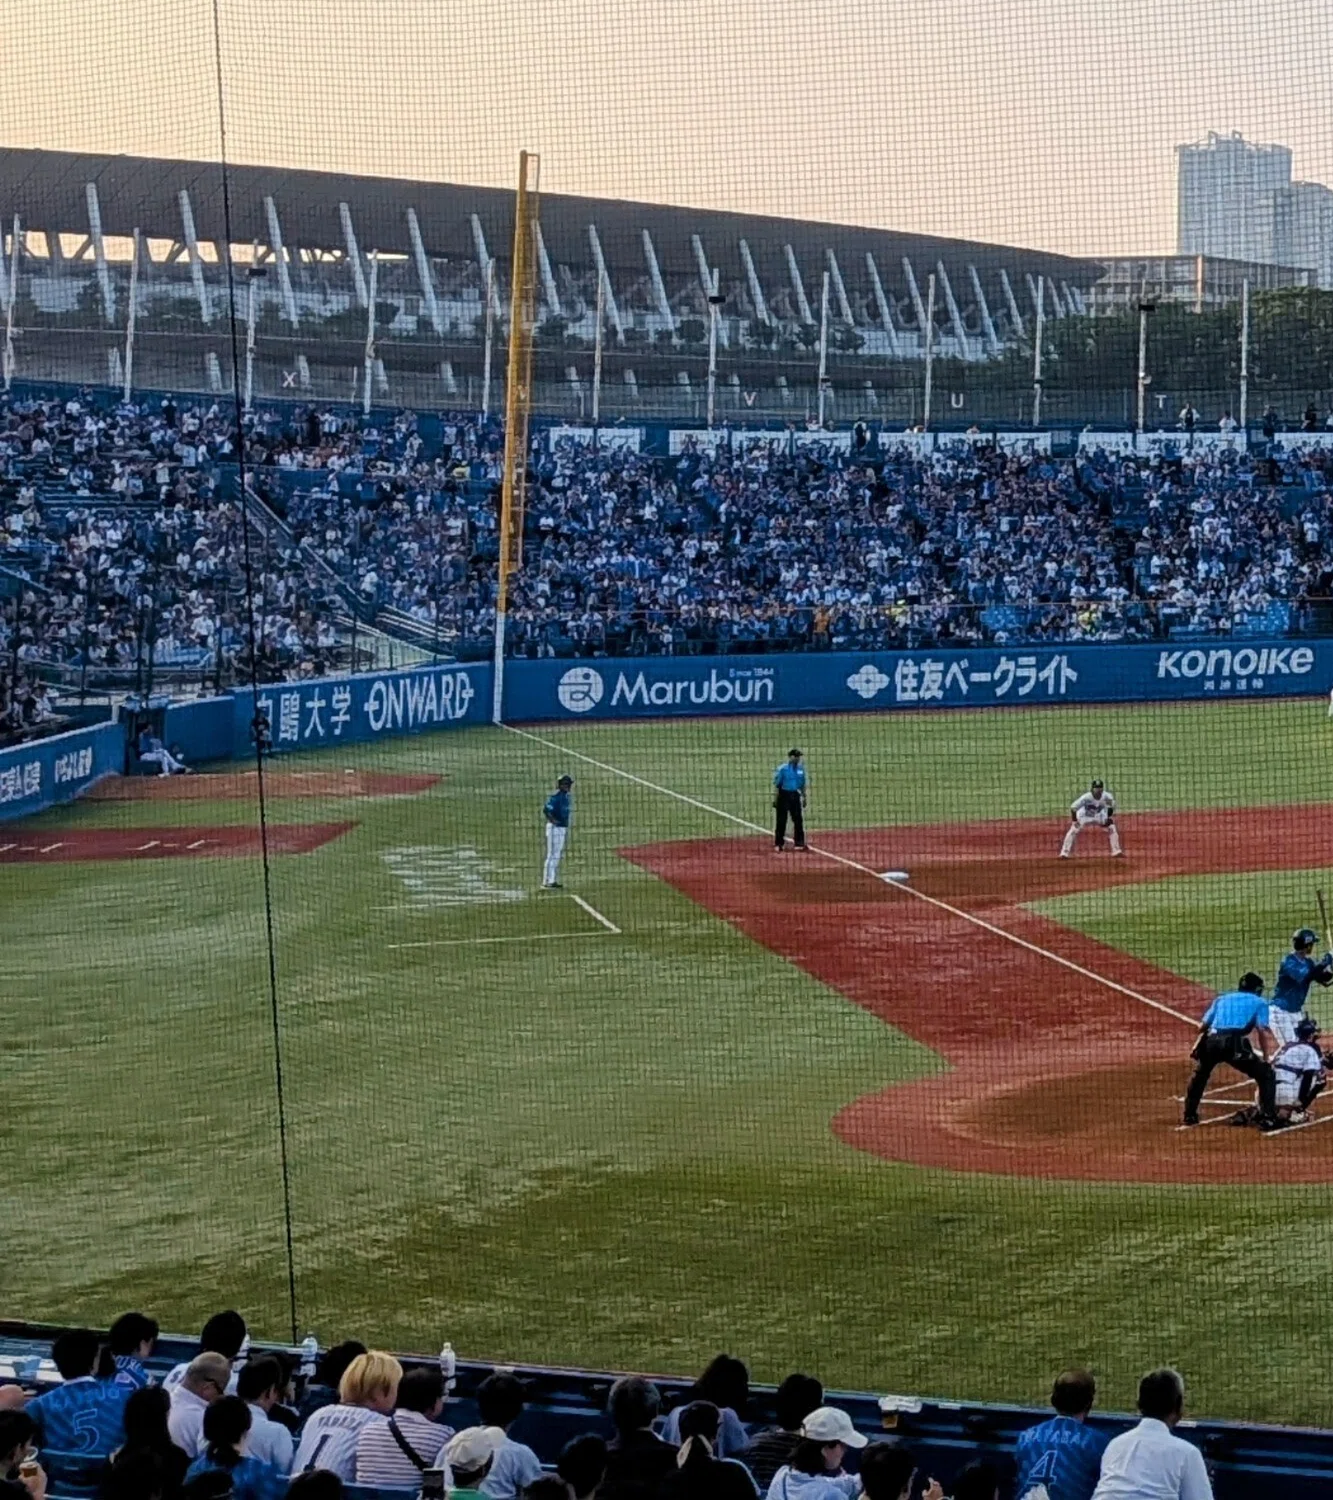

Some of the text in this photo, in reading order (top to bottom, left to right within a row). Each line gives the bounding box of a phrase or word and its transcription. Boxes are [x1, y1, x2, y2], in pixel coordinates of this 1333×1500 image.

[951, 393, 964, 409] U
[1155, 394, 1167, 409] T
[610, 668, 774, 706] Marubun
[894, 653, 1078, 701] 住友ベークライト
[363, 671, 475, 731] ONWARD
[72, 1407, 100, 1453] 5
[1026, 1449, 1058, 1491] 4
